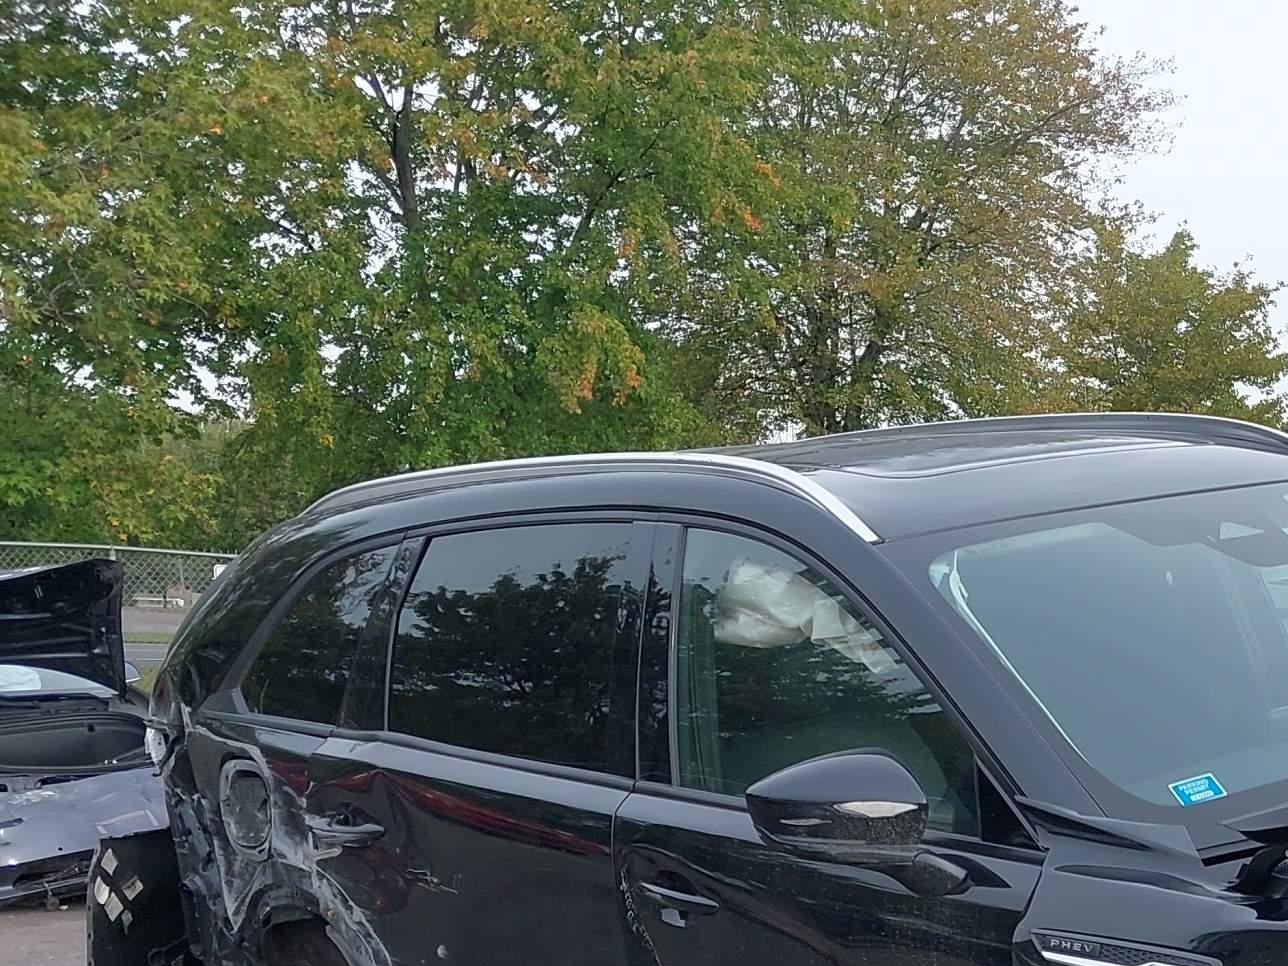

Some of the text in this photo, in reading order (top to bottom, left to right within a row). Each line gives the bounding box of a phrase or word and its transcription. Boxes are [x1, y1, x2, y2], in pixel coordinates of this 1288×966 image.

[1178, 778, 1209, 791] PARKING
[1183, 783, 1209, 795] PERMIT
[1050, 939, 1093, 953] PHEV
